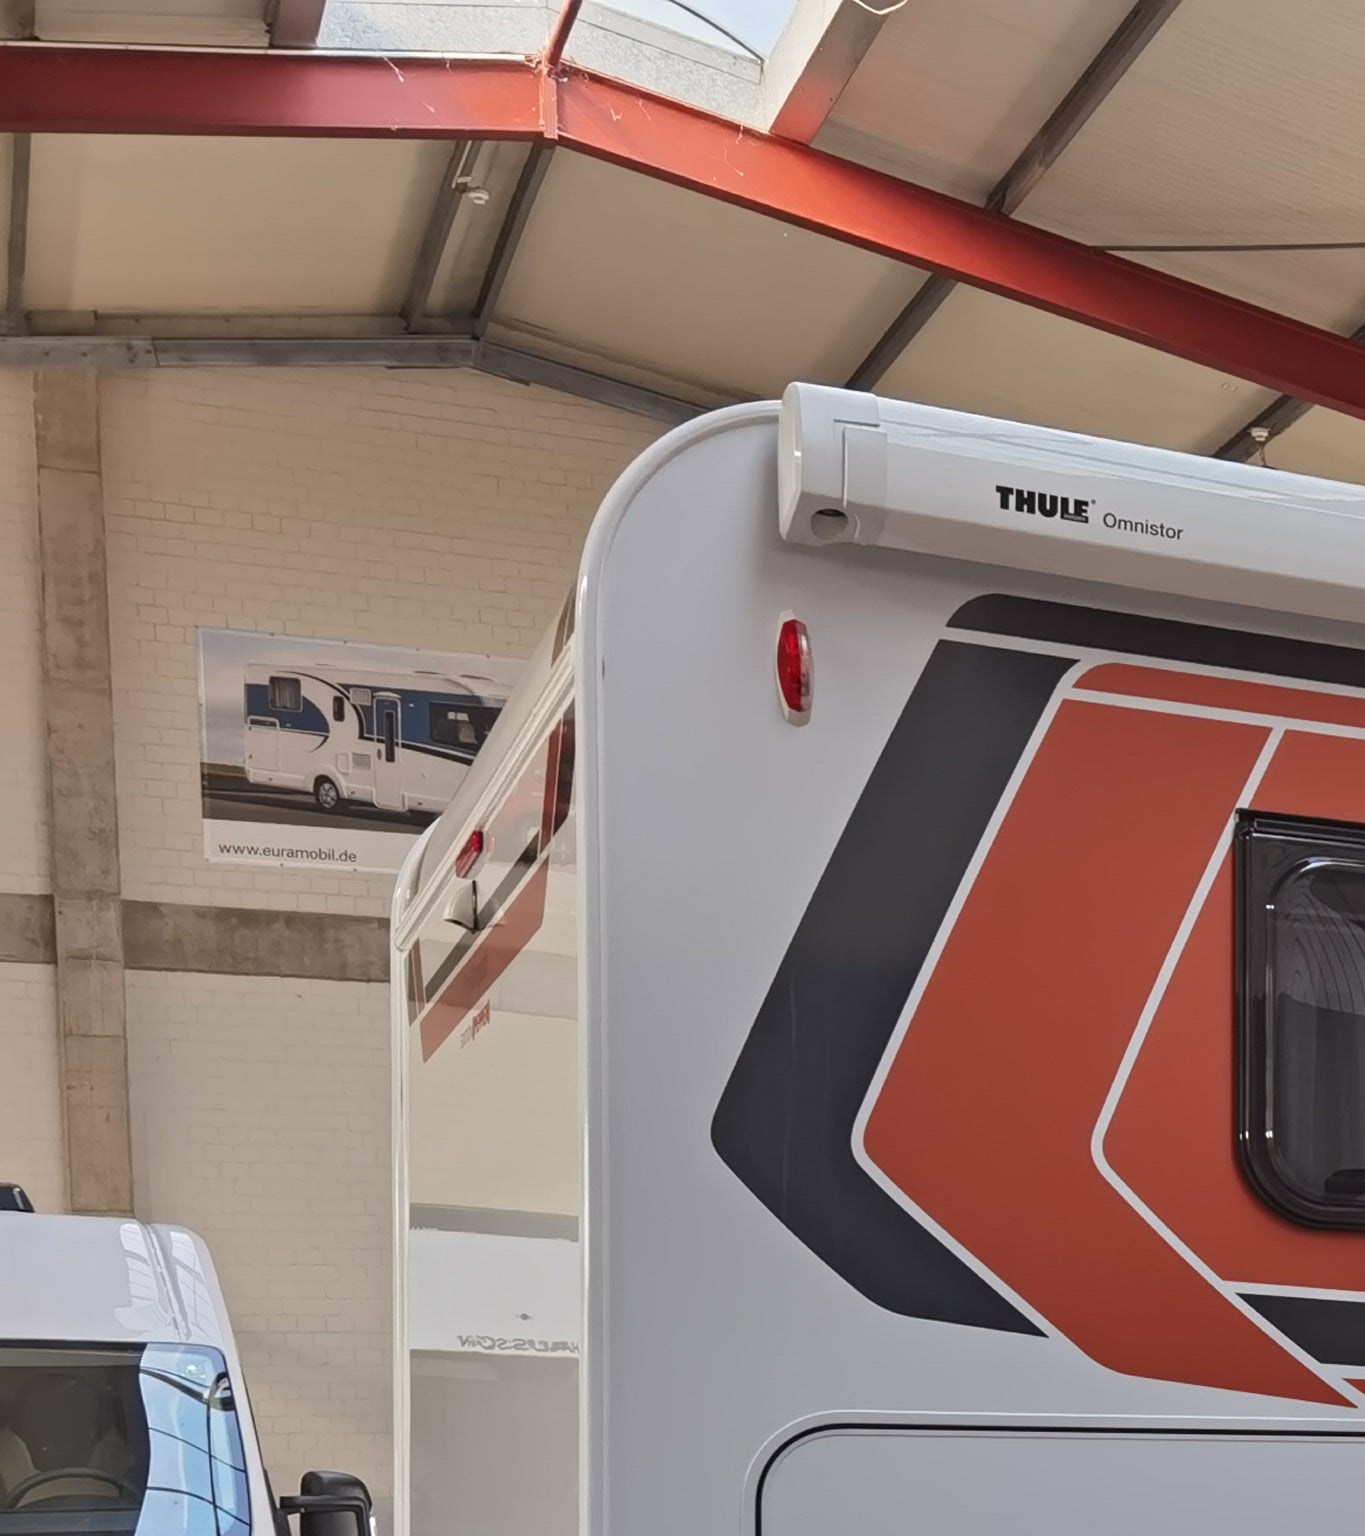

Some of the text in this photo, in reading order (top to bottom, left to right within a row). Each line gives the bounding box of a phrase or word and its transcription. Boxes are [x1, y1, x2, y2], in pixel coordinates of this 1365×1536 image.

[995, 484, 1184, 540] THULE Omnistor
[218, 843, 358, 863] www.euramobil.de
